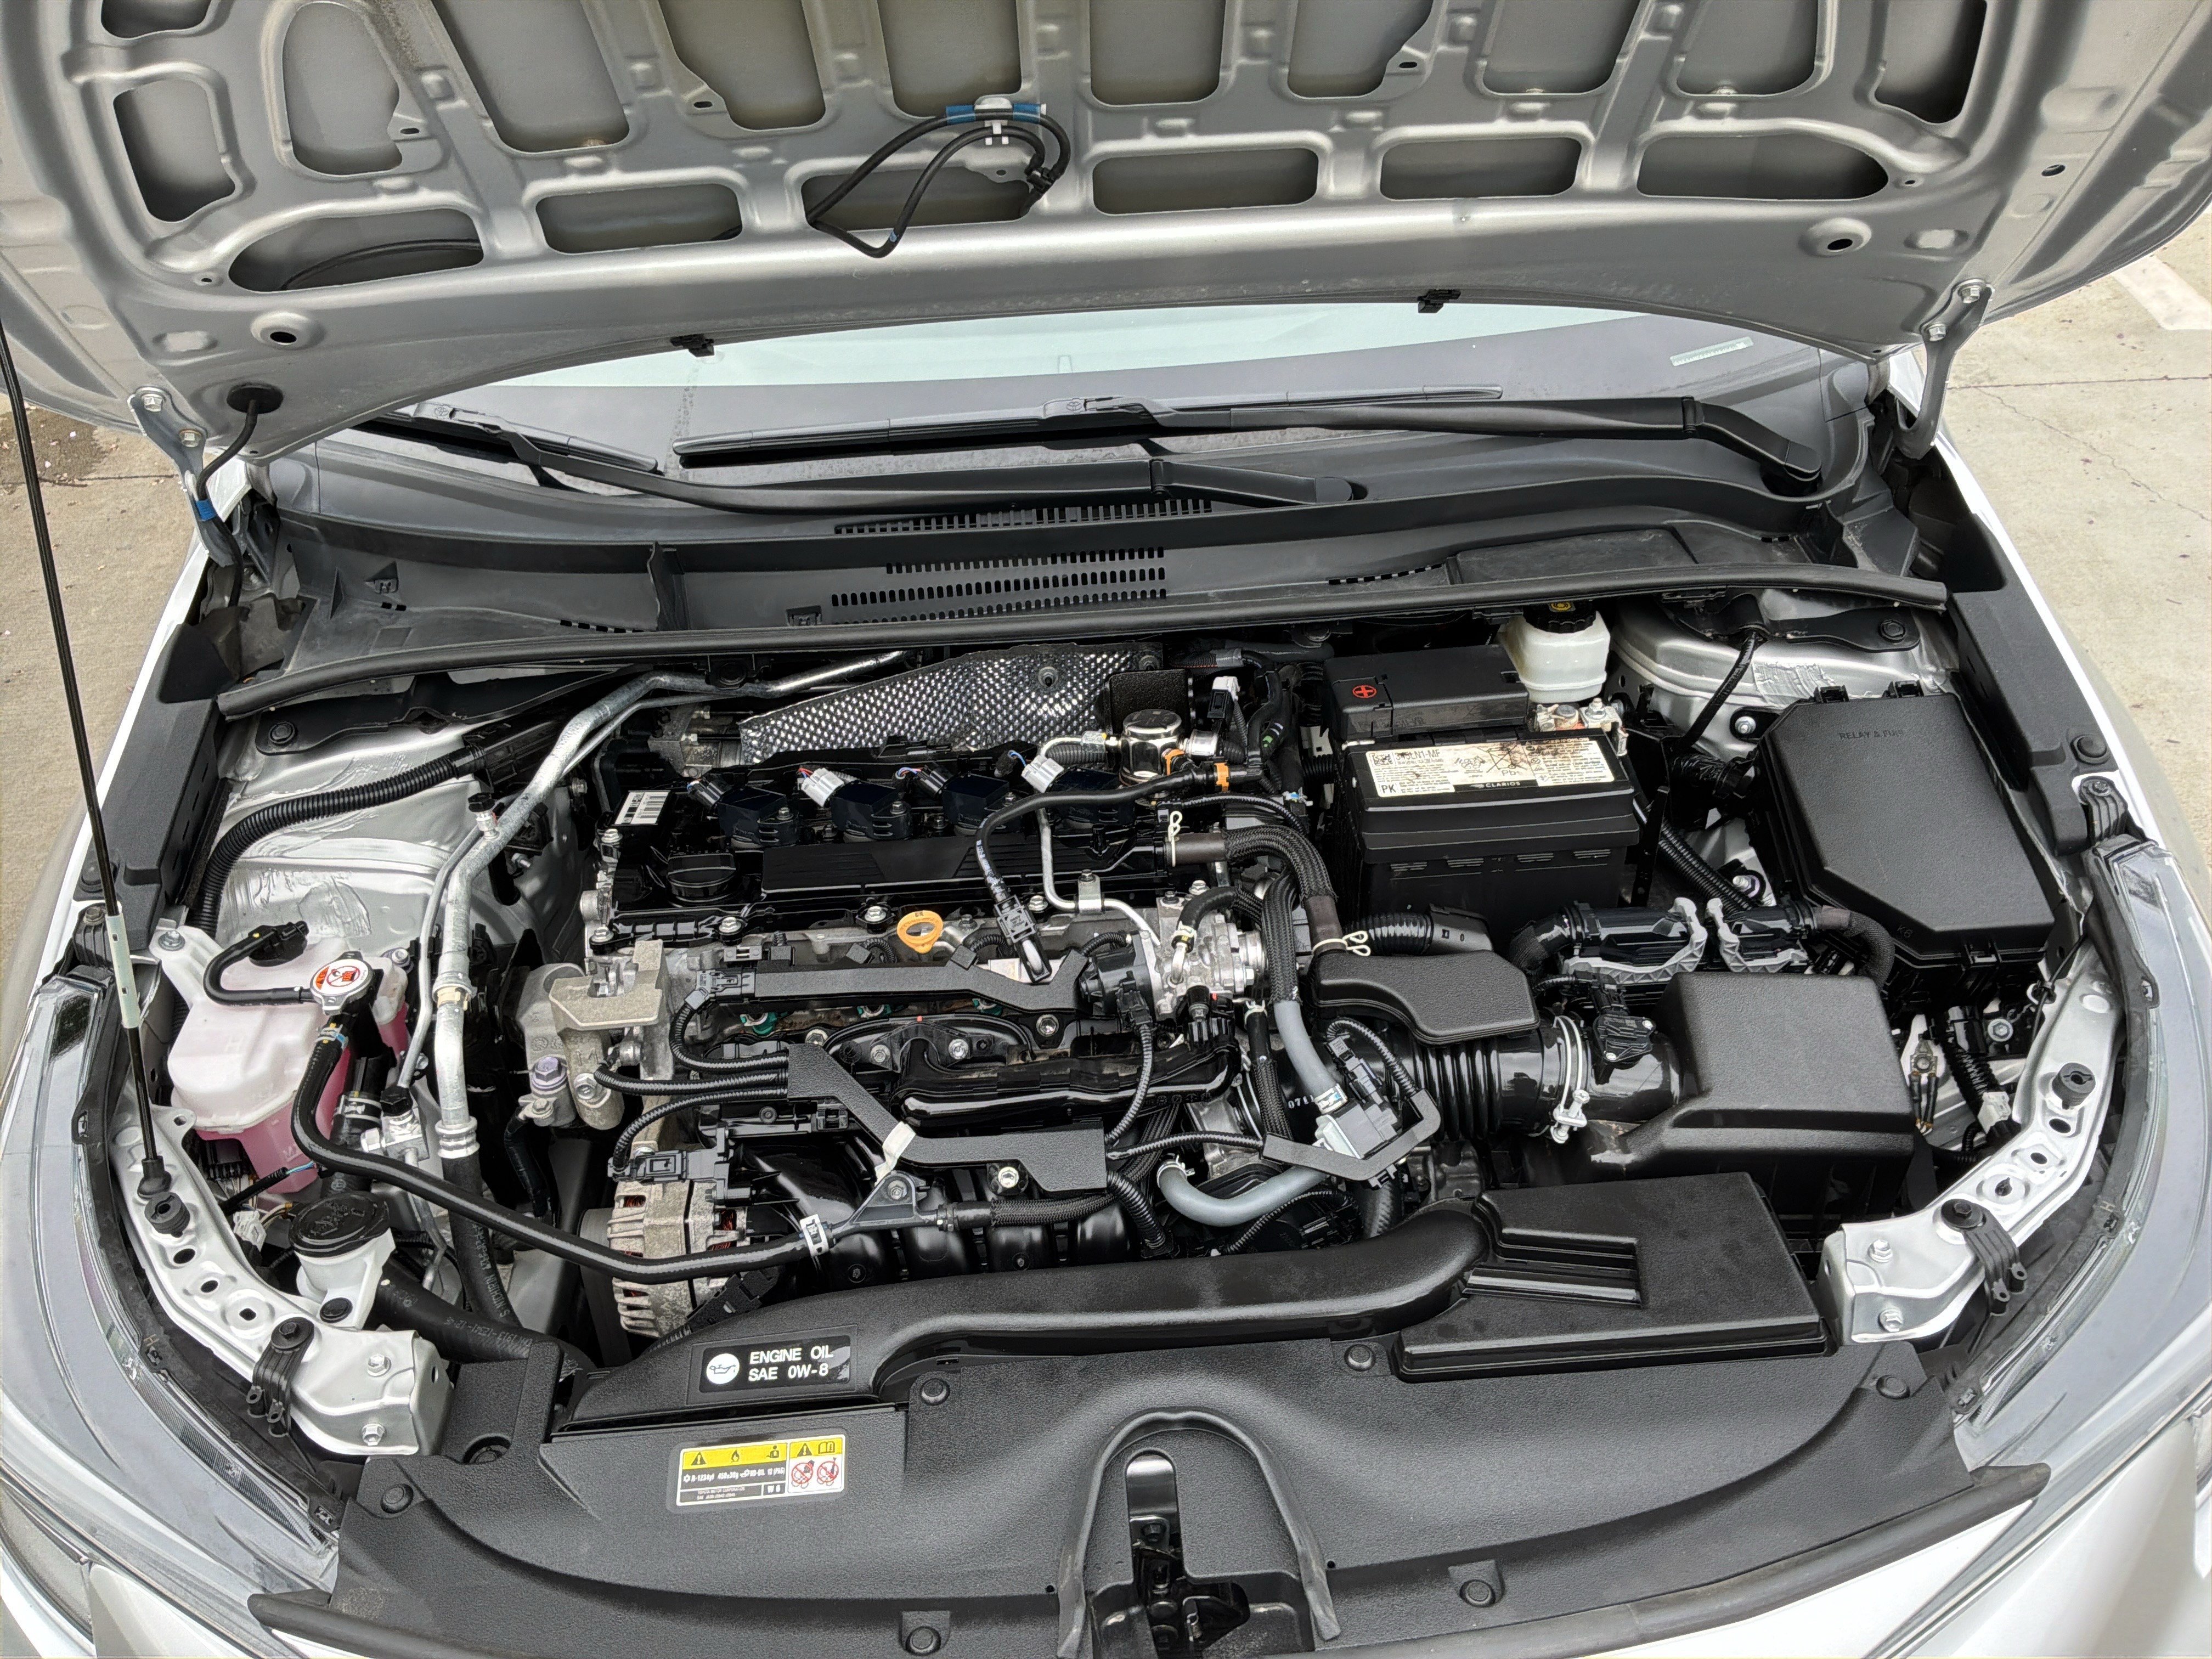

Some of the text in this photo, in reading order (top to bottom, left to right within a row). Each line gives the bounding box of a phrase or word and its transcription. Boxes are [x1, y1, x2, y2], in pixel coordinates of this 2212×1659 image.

[1838, 731, 1870, 740] RELAY
[1381, 784, 1397, 794] PK
[483, 1273, 506, 1310] NICHIRIN
[749, 1345, 834, 1365] ENGINE OIL
[748, 1363, 829, 1381] SAE 0W-8
